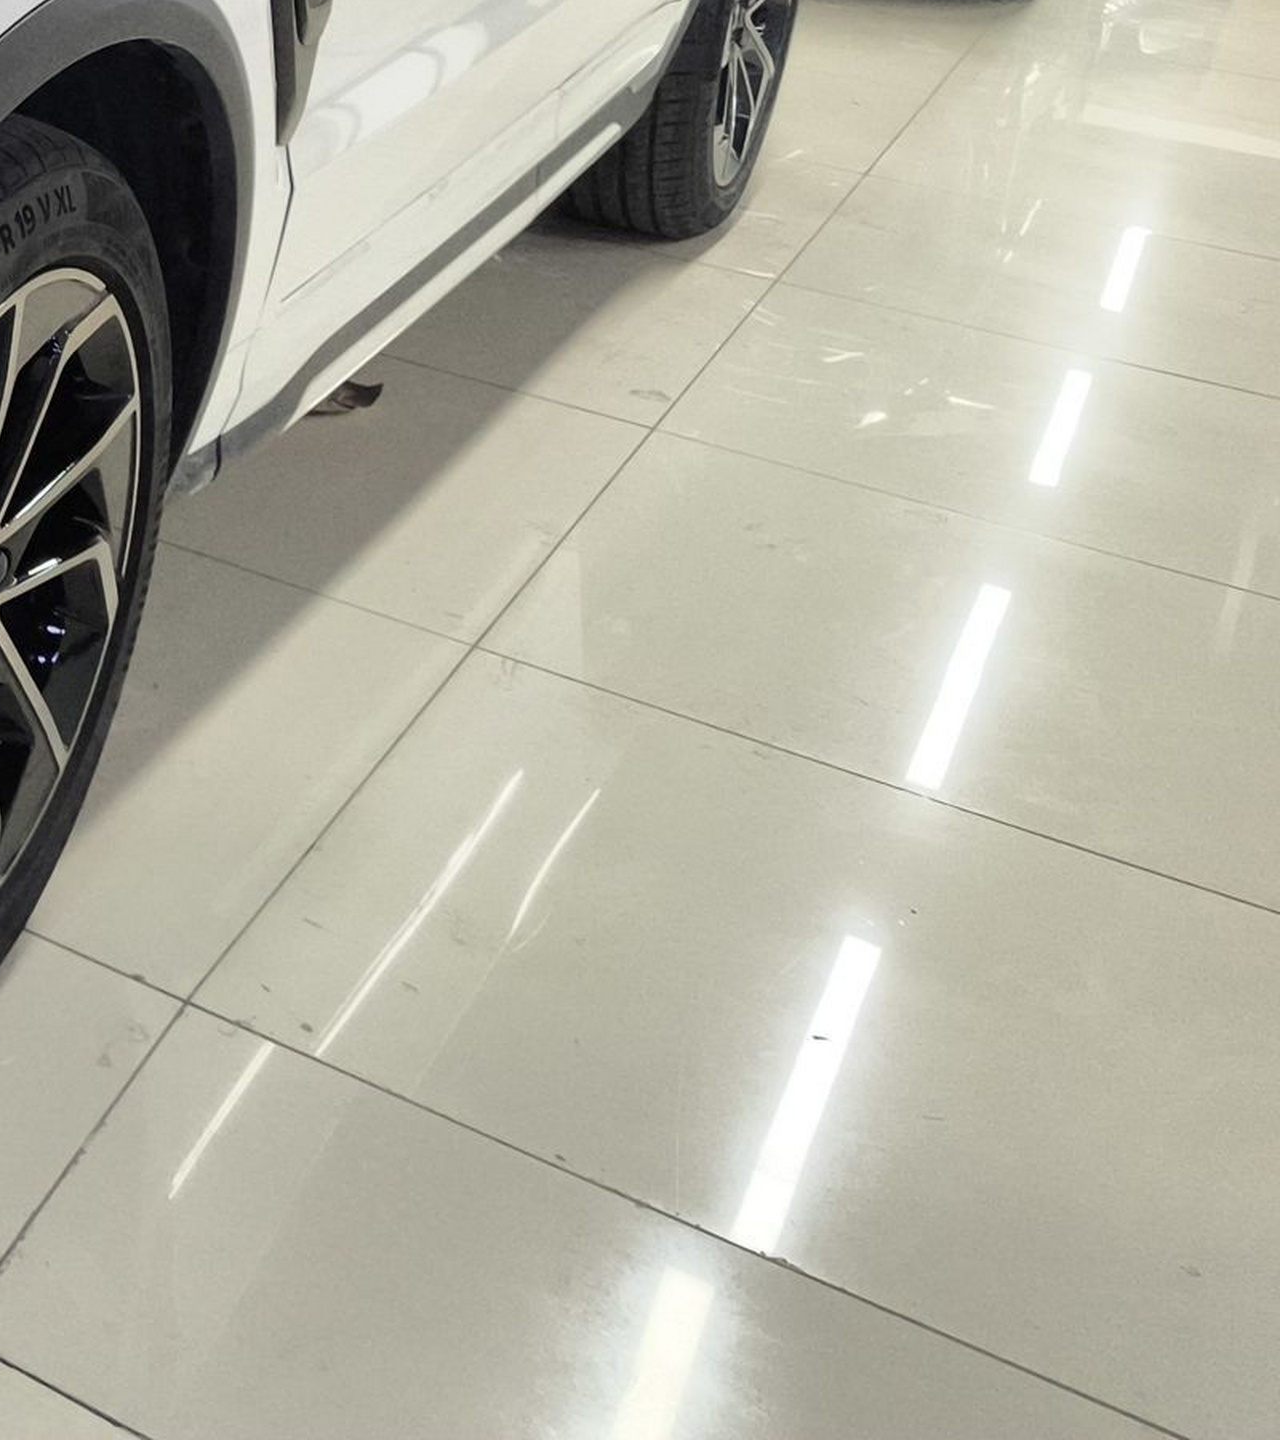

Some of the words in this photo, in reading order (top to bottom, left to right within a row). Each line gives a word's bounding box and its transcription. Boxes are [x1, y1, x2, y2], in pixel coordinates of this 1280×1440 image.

[14, 205, 36, 239] 19
[36, 192, 51, 224] V
[53, 184, 78, 217] XL
